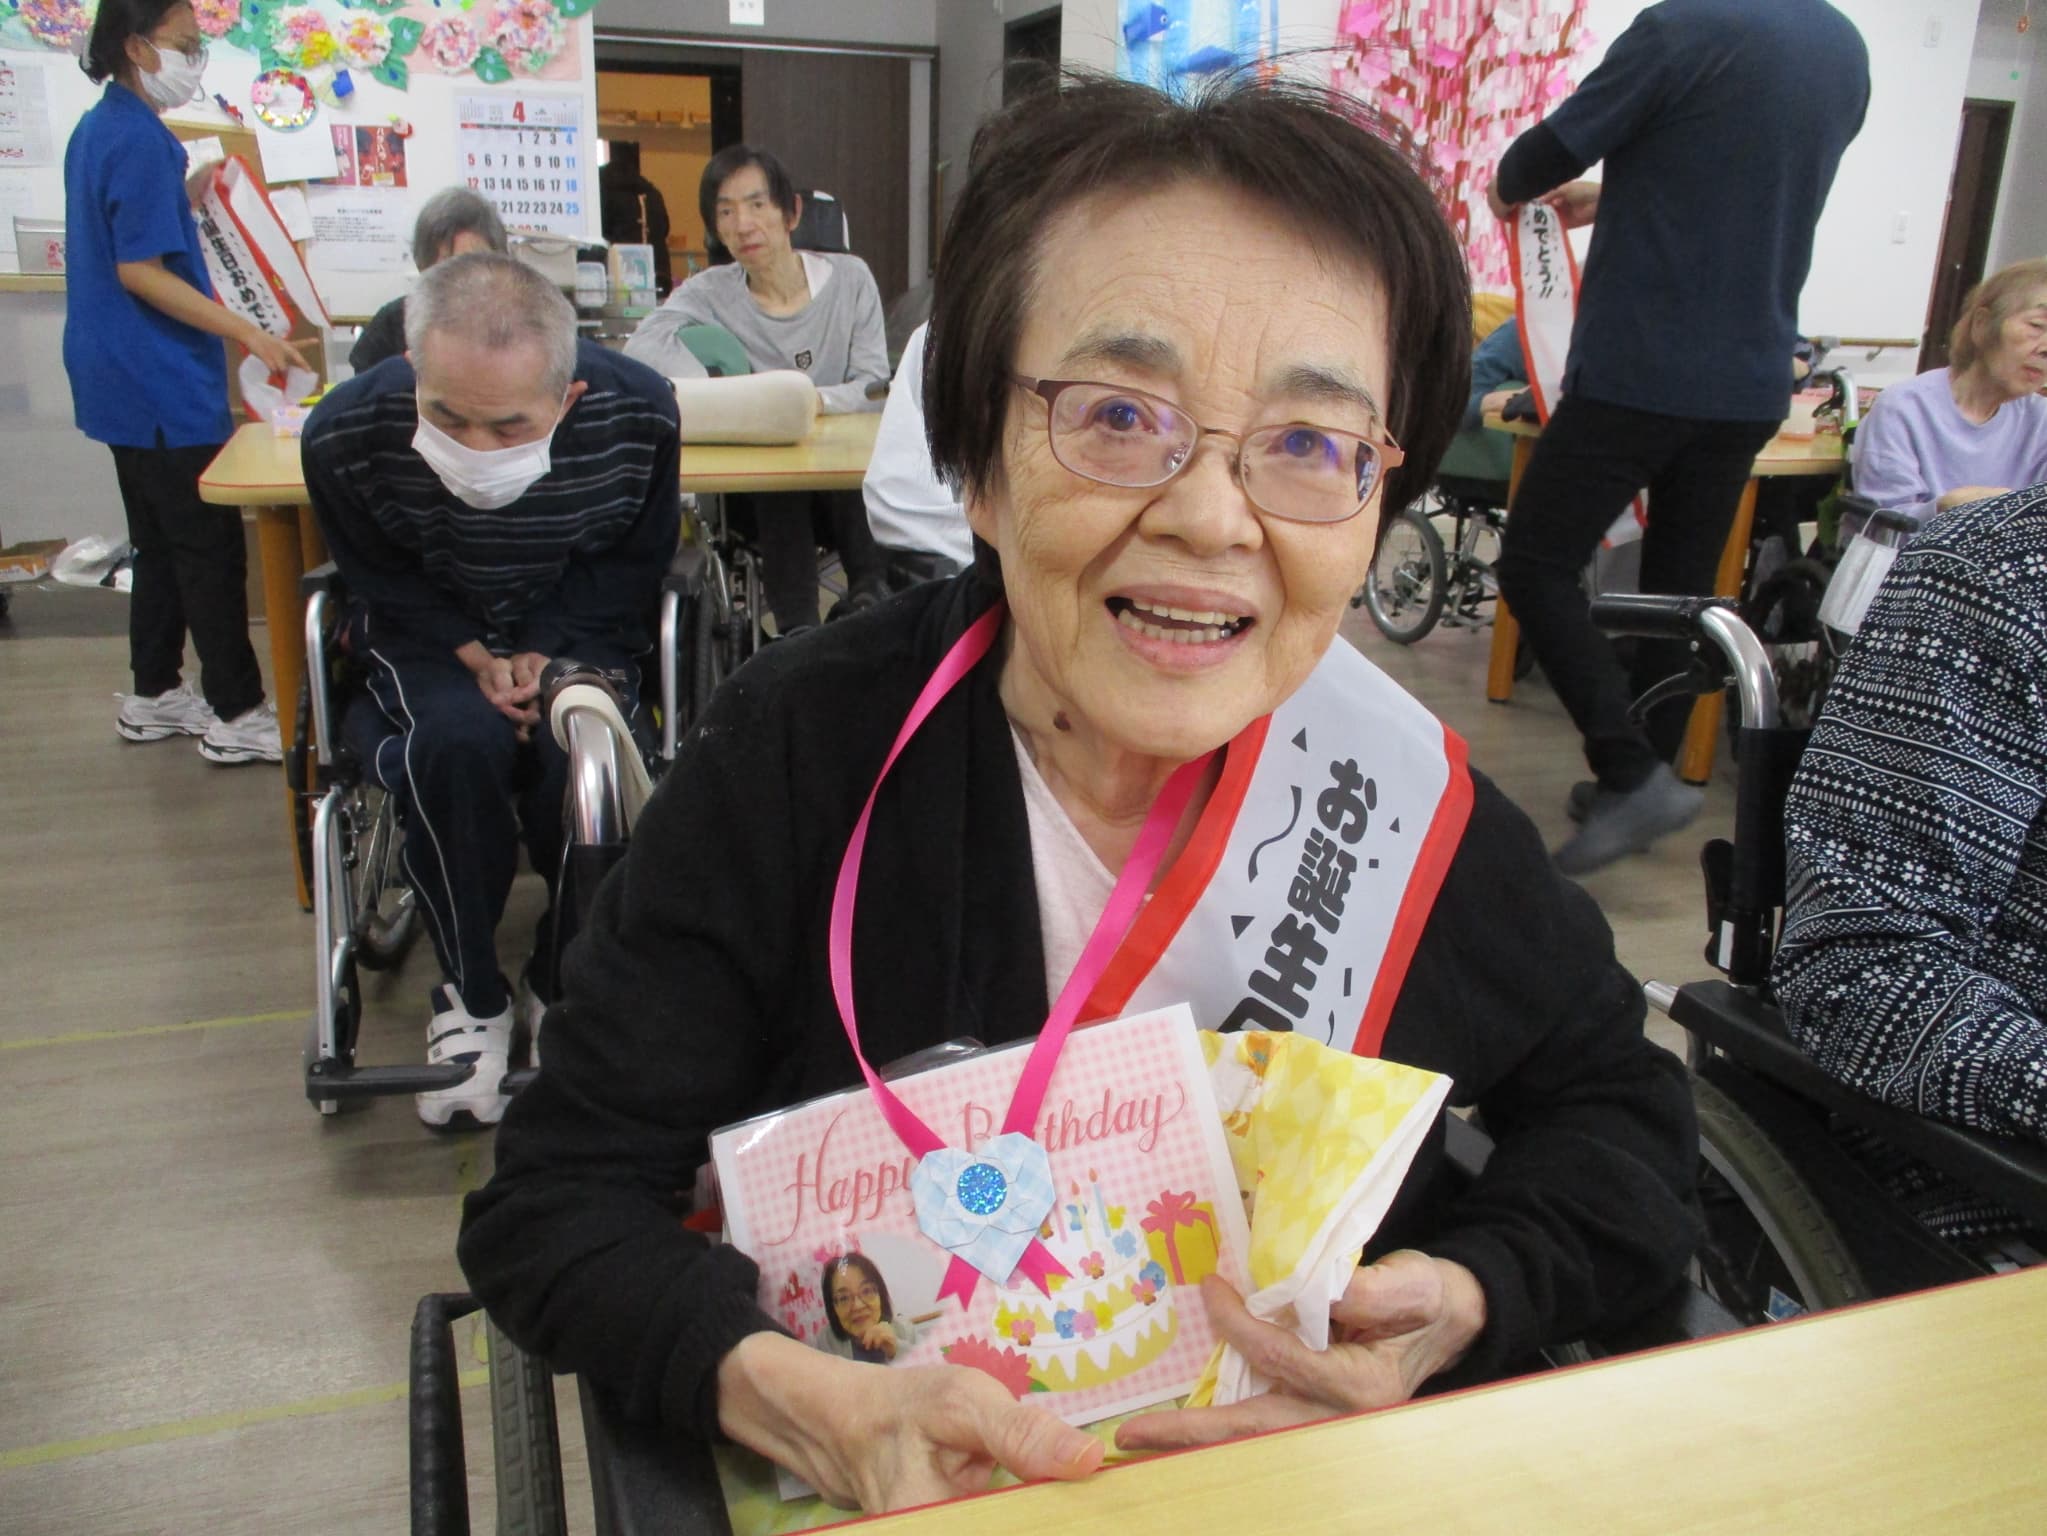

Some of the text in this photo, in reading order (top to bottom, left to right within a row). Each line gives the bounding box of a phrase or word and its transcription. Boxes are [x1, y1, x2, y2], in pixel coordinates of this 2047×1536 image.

[513, 101, 526, 123] 4
[518, 132, 573, 145] 1 2 3 4
[468, 153, 576, 168] 5 6 7 8 9 10 11
[467, 177, 577, 192] 12 13 14 15 16 17 18
[501, 201, 513, 213] 21
[517, 201, 530, 214] 22
[533, 201, 547, 214] 23
[550, 202, 563, 215] 24
[565, 202, 579, 215] 25
